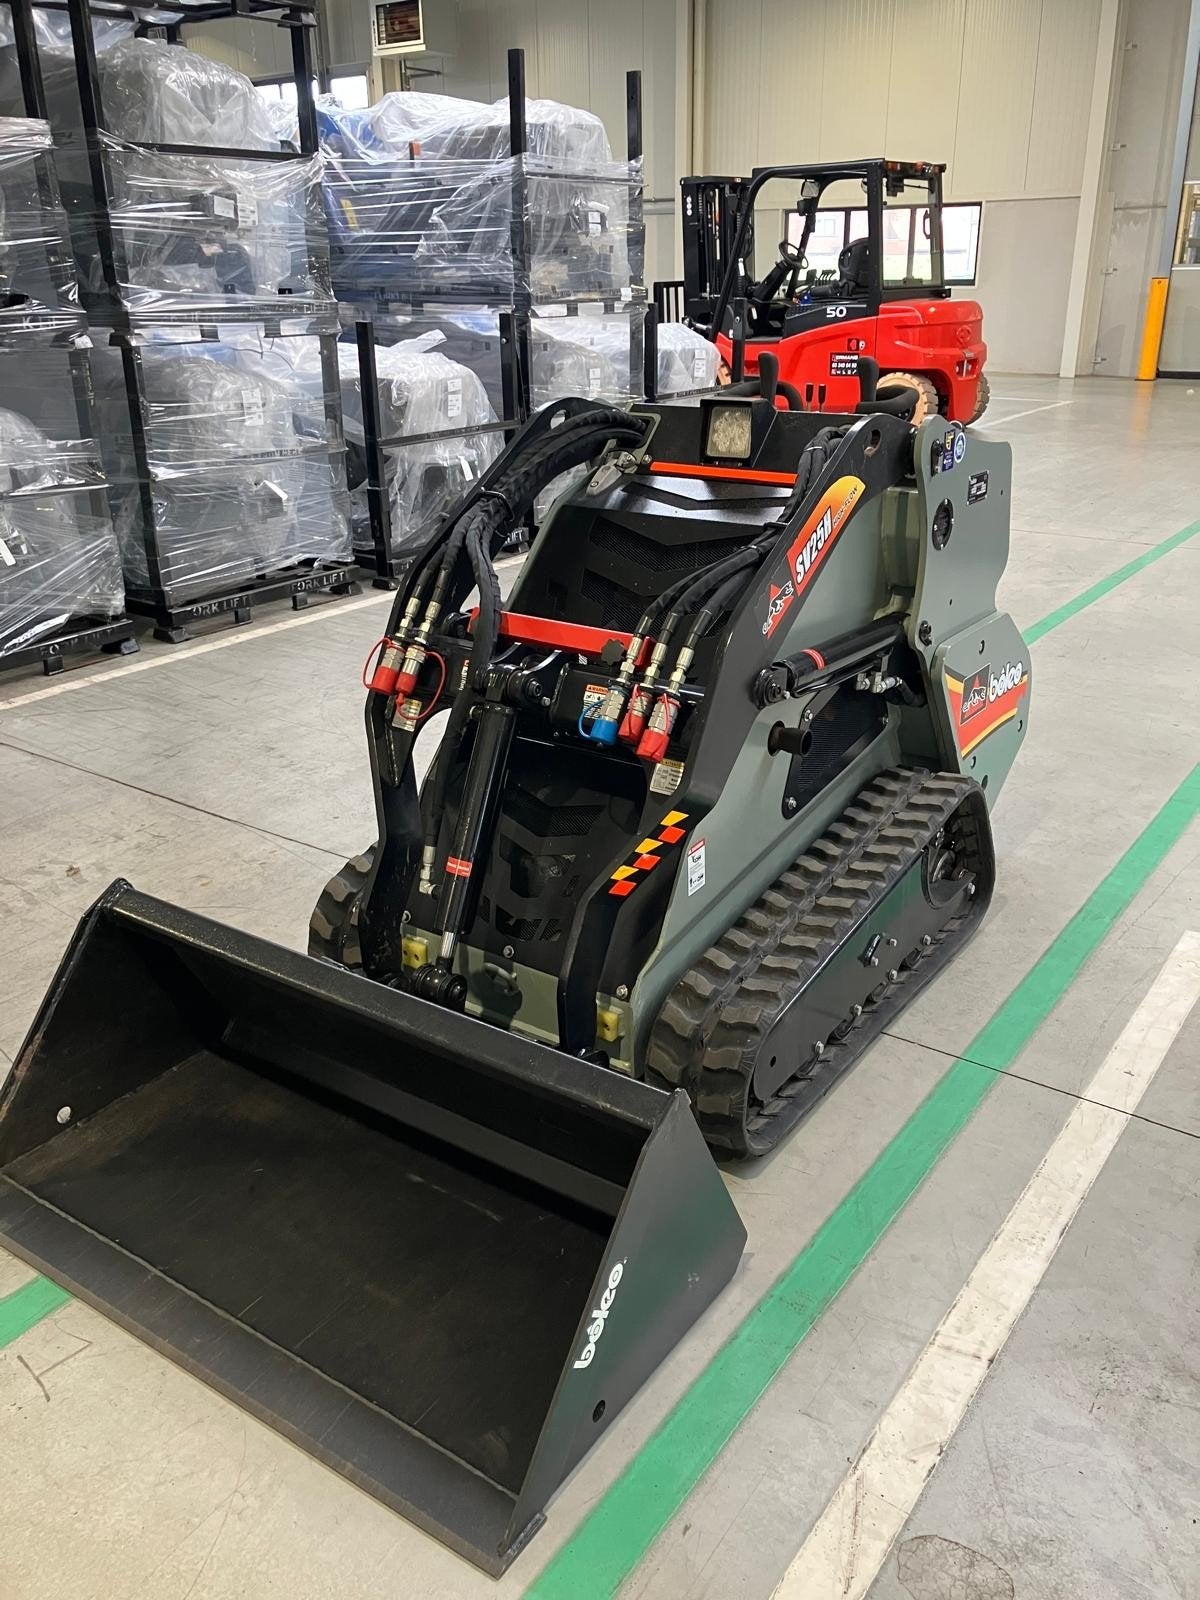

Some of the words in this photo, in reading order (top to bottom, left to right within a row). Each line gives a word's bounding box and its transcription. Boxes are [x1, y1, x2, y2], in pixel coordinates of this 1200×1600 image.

[826, 306, 847, 318] 50
[795, 505, 833, 584] SV25H
[323, 570, 345, 586] LIFT
[223, 595, 249, 612] LIFT
